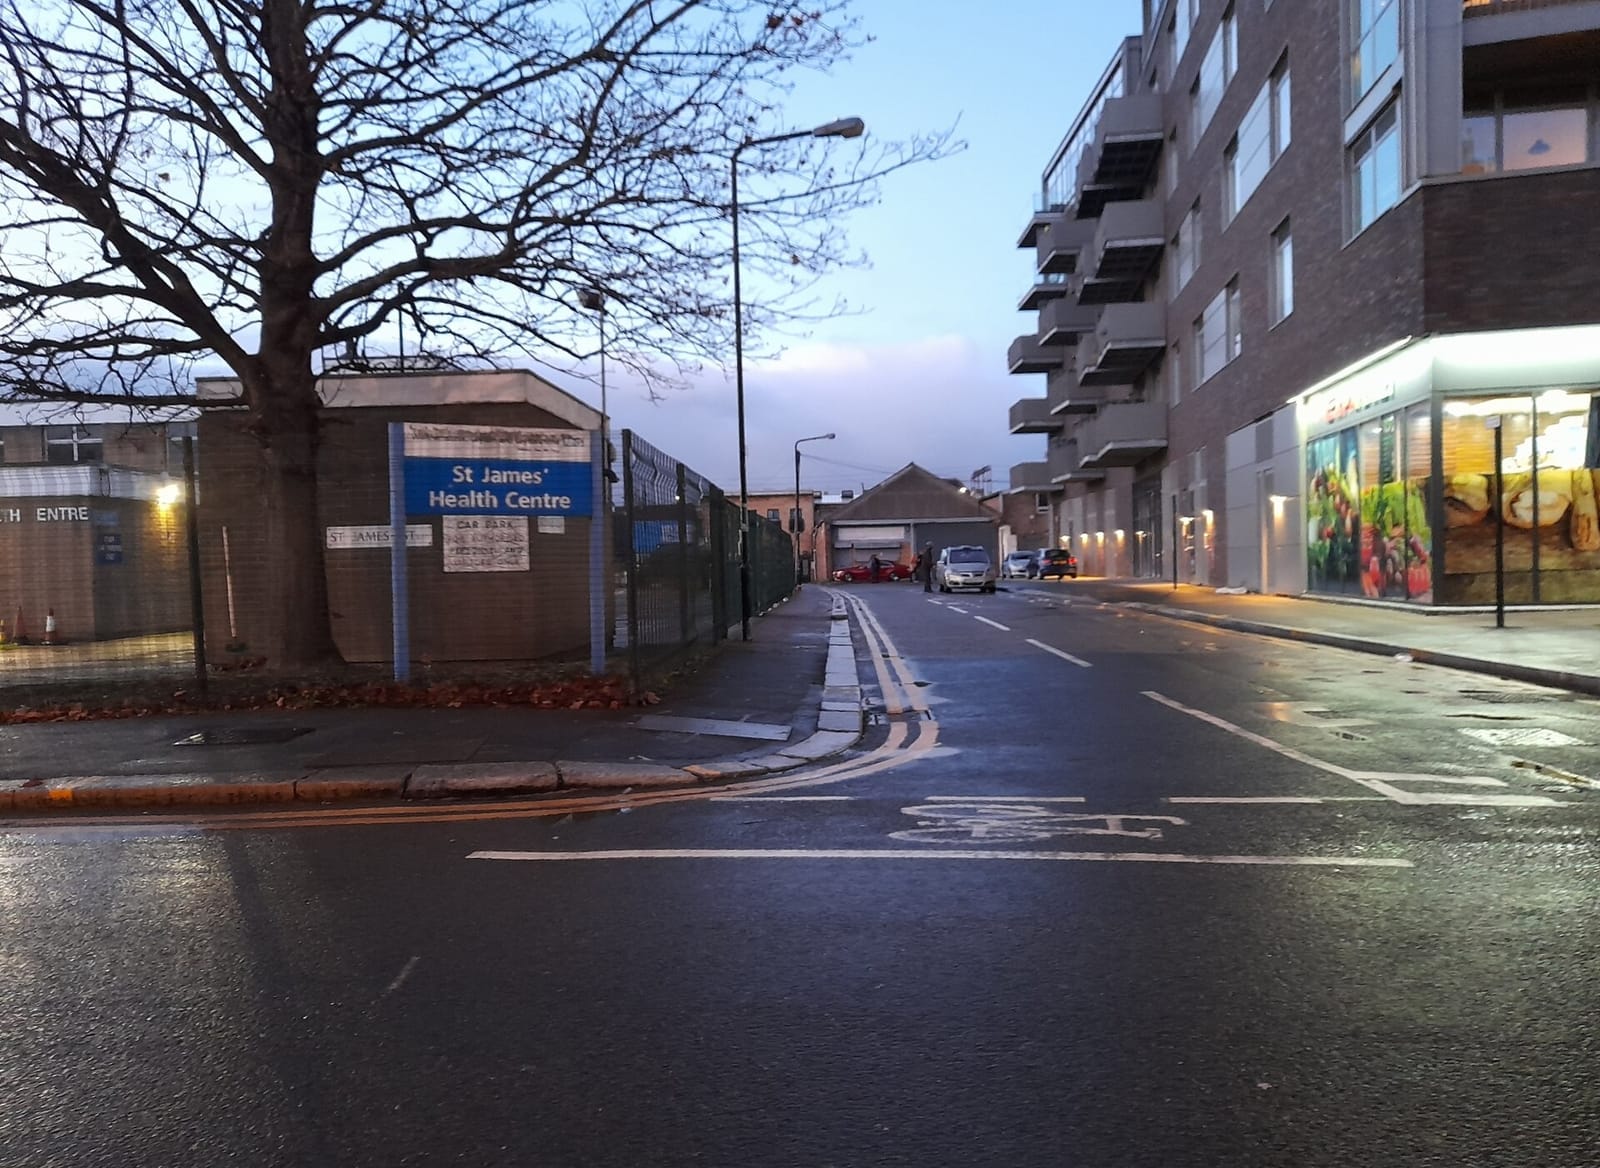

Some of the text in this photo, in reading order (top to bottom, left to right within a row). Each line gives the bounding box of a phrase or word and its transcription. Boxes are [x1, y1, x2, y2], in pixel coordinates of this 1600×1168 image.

[452, 465, 549, 485] St James'
[429, 489, 571, 509] Health Centre
[37, 506, 89, 521] ENTRE
[456, 520, 513, 529] CAR PARK
[330, 531, 345, 543] ST
